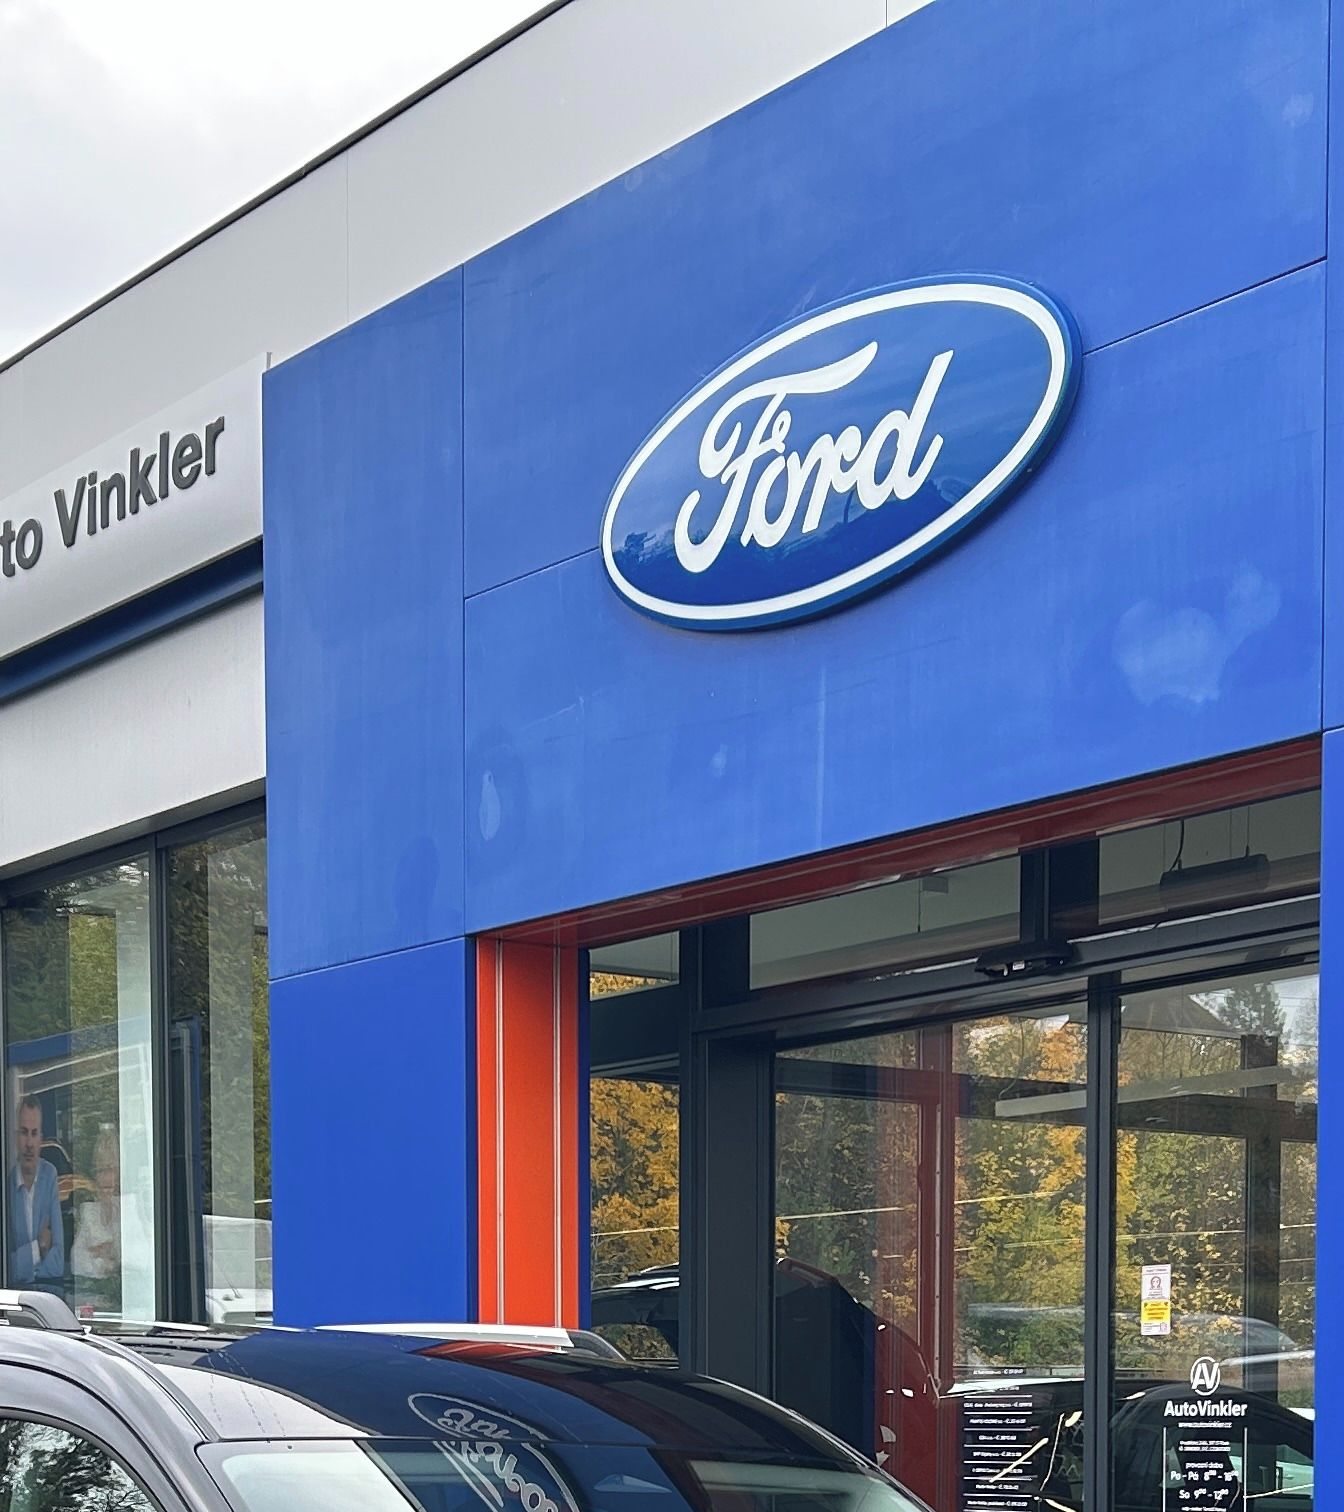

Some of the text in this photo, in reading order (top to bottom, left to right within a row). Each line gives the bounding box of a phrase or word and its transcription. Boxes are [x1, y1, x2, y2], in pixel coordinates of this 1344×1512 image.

[53, 415, 225, 549] Vinkler
[674, 341, 953, 573] Ford
[1163, 1399, 1248, 1417] AutoVinkler
